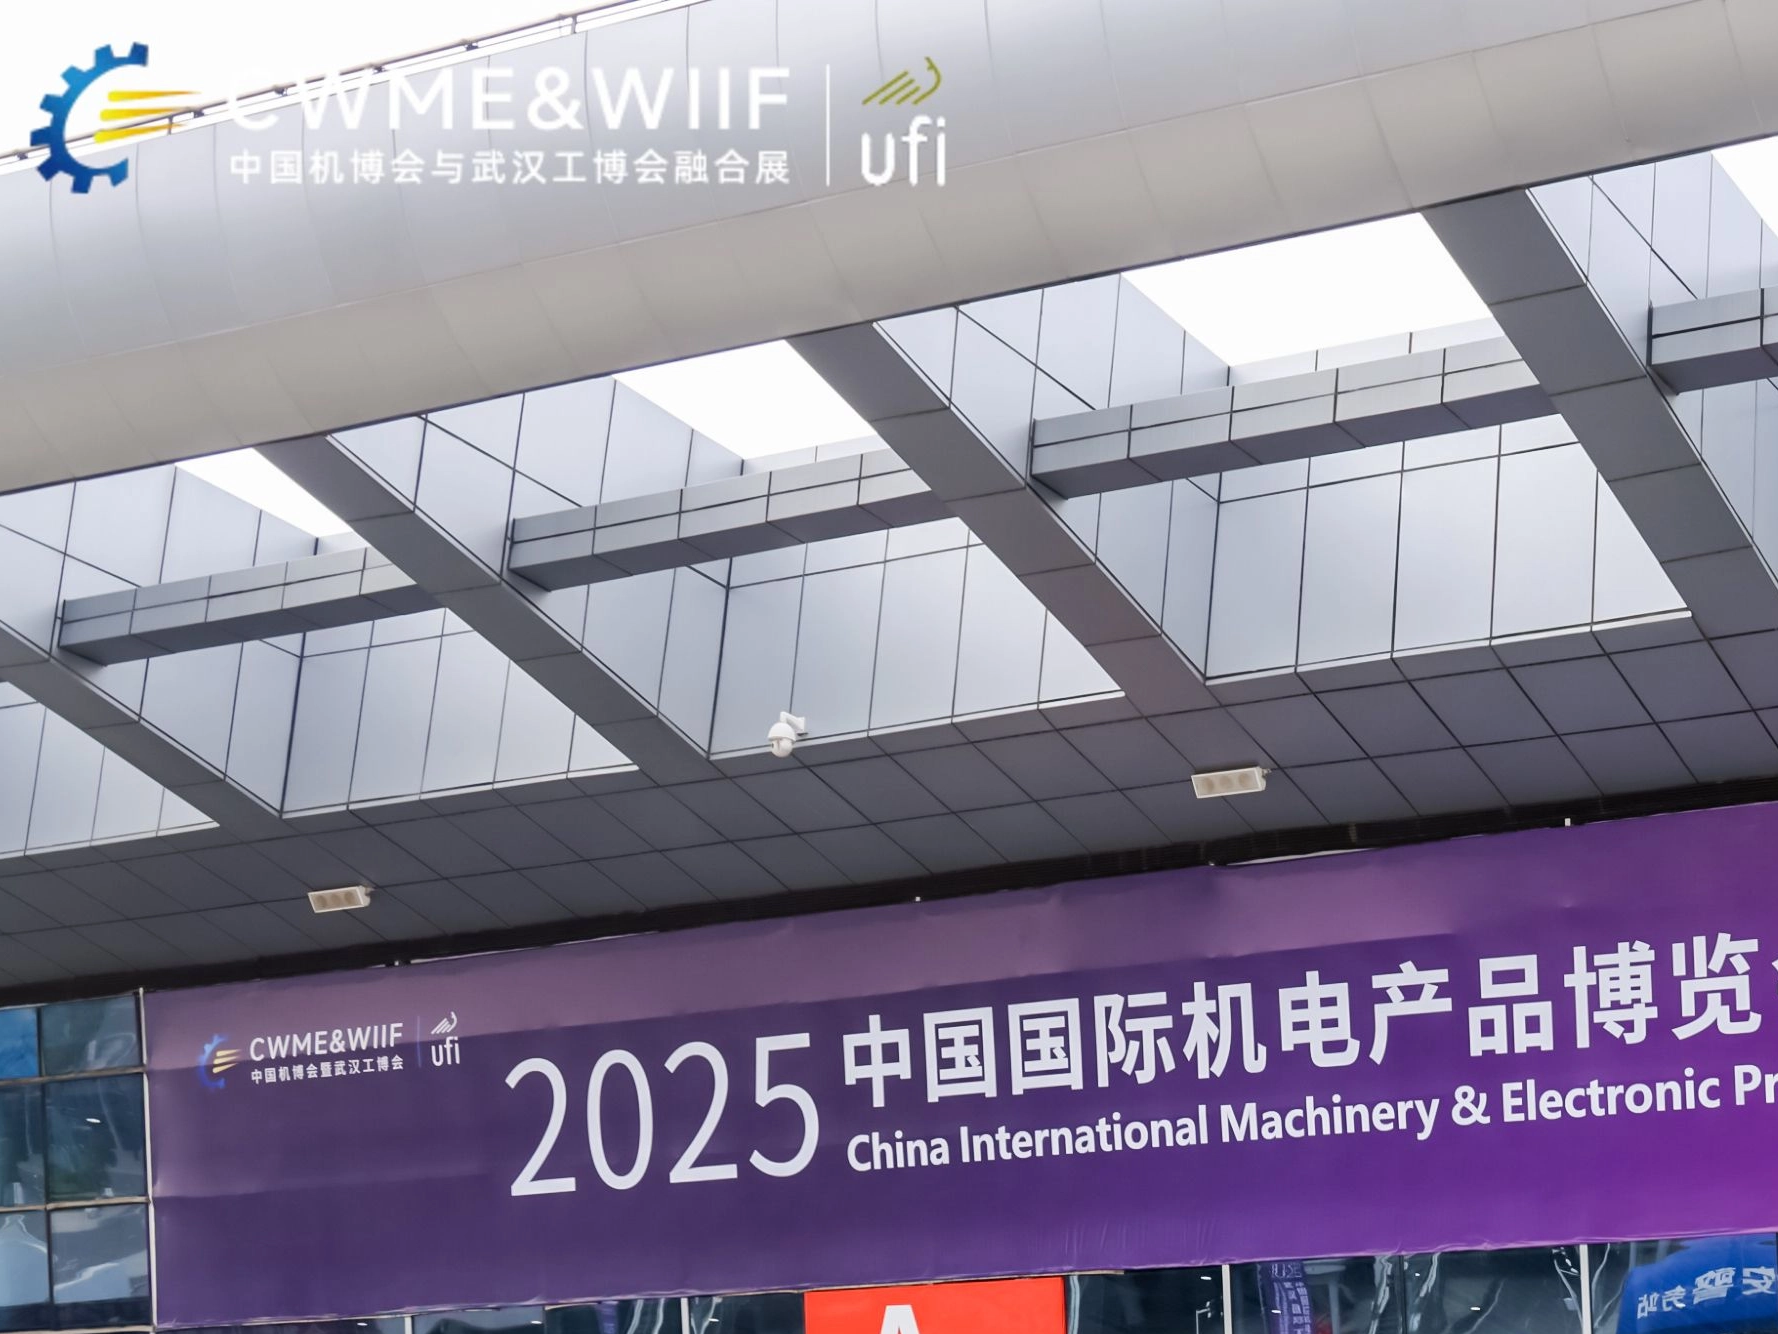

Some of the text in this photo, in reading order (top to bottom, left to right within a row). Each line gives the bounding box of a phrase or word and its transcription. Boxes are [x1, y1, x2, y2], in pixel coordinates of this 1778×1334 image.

[250, 1022, 403, 1061] CWME&WIIF
[430, 1035, 460, 1067] ufi
[251, 1054, 404, 1085] 中国机博会暨武汉工博会
[505, 1033, 819, 1197] 2025
[847, 1129, 949, 1172] China
[961, 1104, 1209, 1163] International
[1219, 1093, 1441, 1141] Machinery
[1450, 1085, 1490, 1127] &
[1502, 1067, 1721, 1123] Electronic
